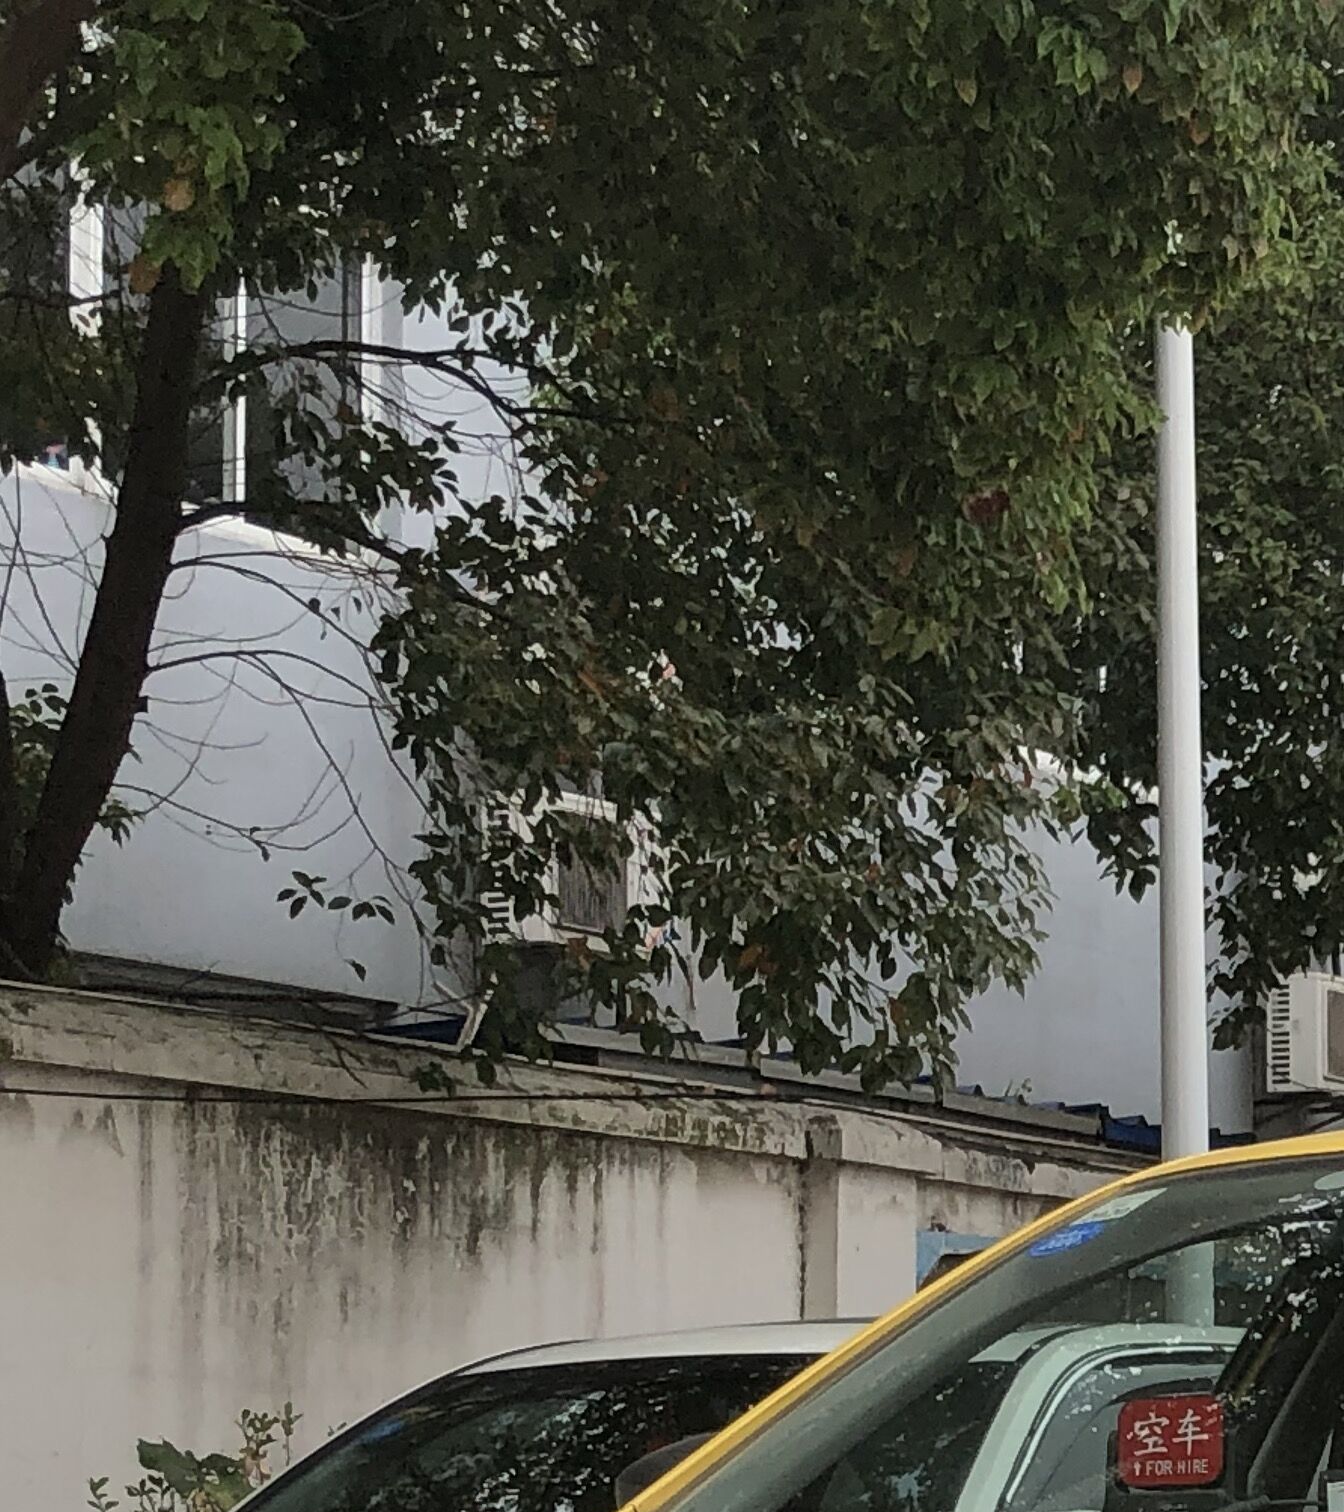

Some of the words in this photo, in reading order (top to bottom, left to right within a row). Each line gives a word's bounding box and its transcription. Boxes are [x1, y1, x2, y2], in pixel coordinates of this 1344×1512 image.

[1133, 1408, 1209, 1456] 空车
[1145, 1460, 1173, 1477] FOR
[1177, 1458, 1209, 1475] HIRE
